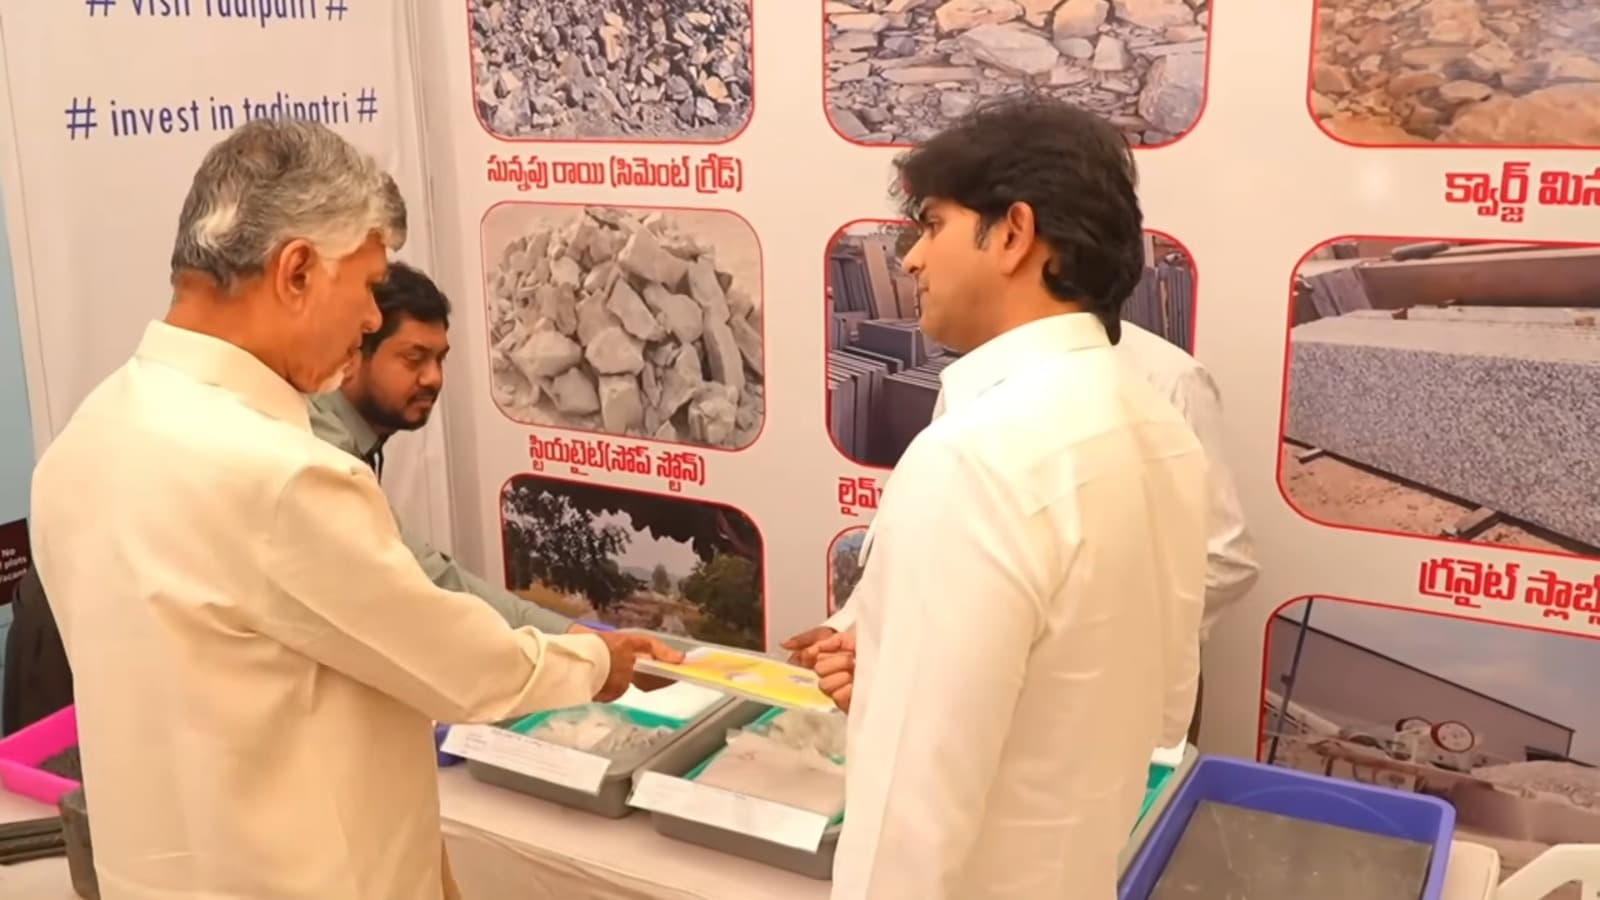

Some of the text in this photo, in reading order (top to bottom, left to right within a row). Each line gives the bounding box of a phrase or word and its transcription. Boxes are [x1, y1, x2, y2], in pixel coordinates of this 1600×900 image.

[110, 100, 199, 136] invest
[209, 96, 234, 131] in
[487, 154, 549, 191] సున్నపు
[552, 160, 605, 186] రాయి
[609, 155, 691, 189] (సిమెంట్
[838, 476, 883, 517] లైమ్
